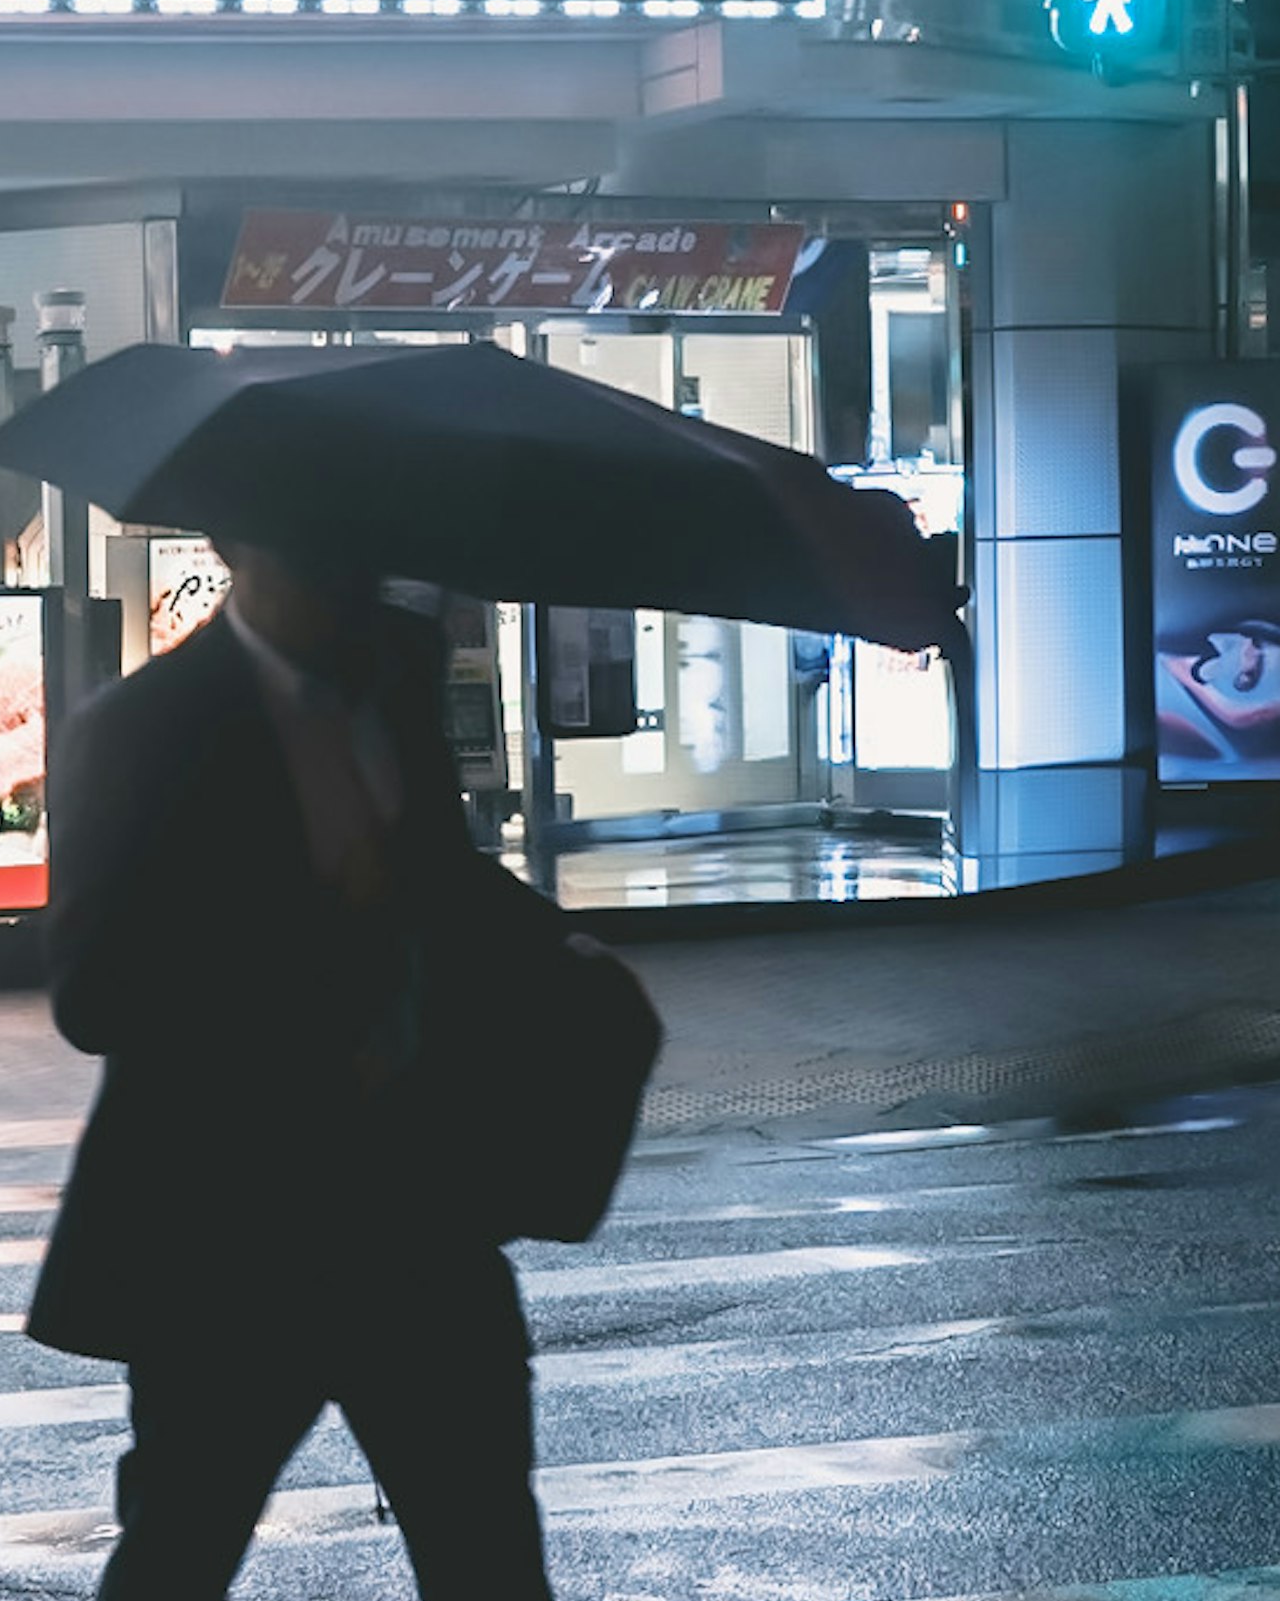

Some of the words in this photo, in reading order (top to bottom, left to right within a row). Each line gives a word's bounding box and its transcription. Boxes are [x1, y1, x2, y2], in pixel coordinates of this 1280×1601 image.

[324, 214, 546, 249] Amusement
[567, 221, 697, 252] Arcade
[290, 246, 615, 309] クレーンゲーム
